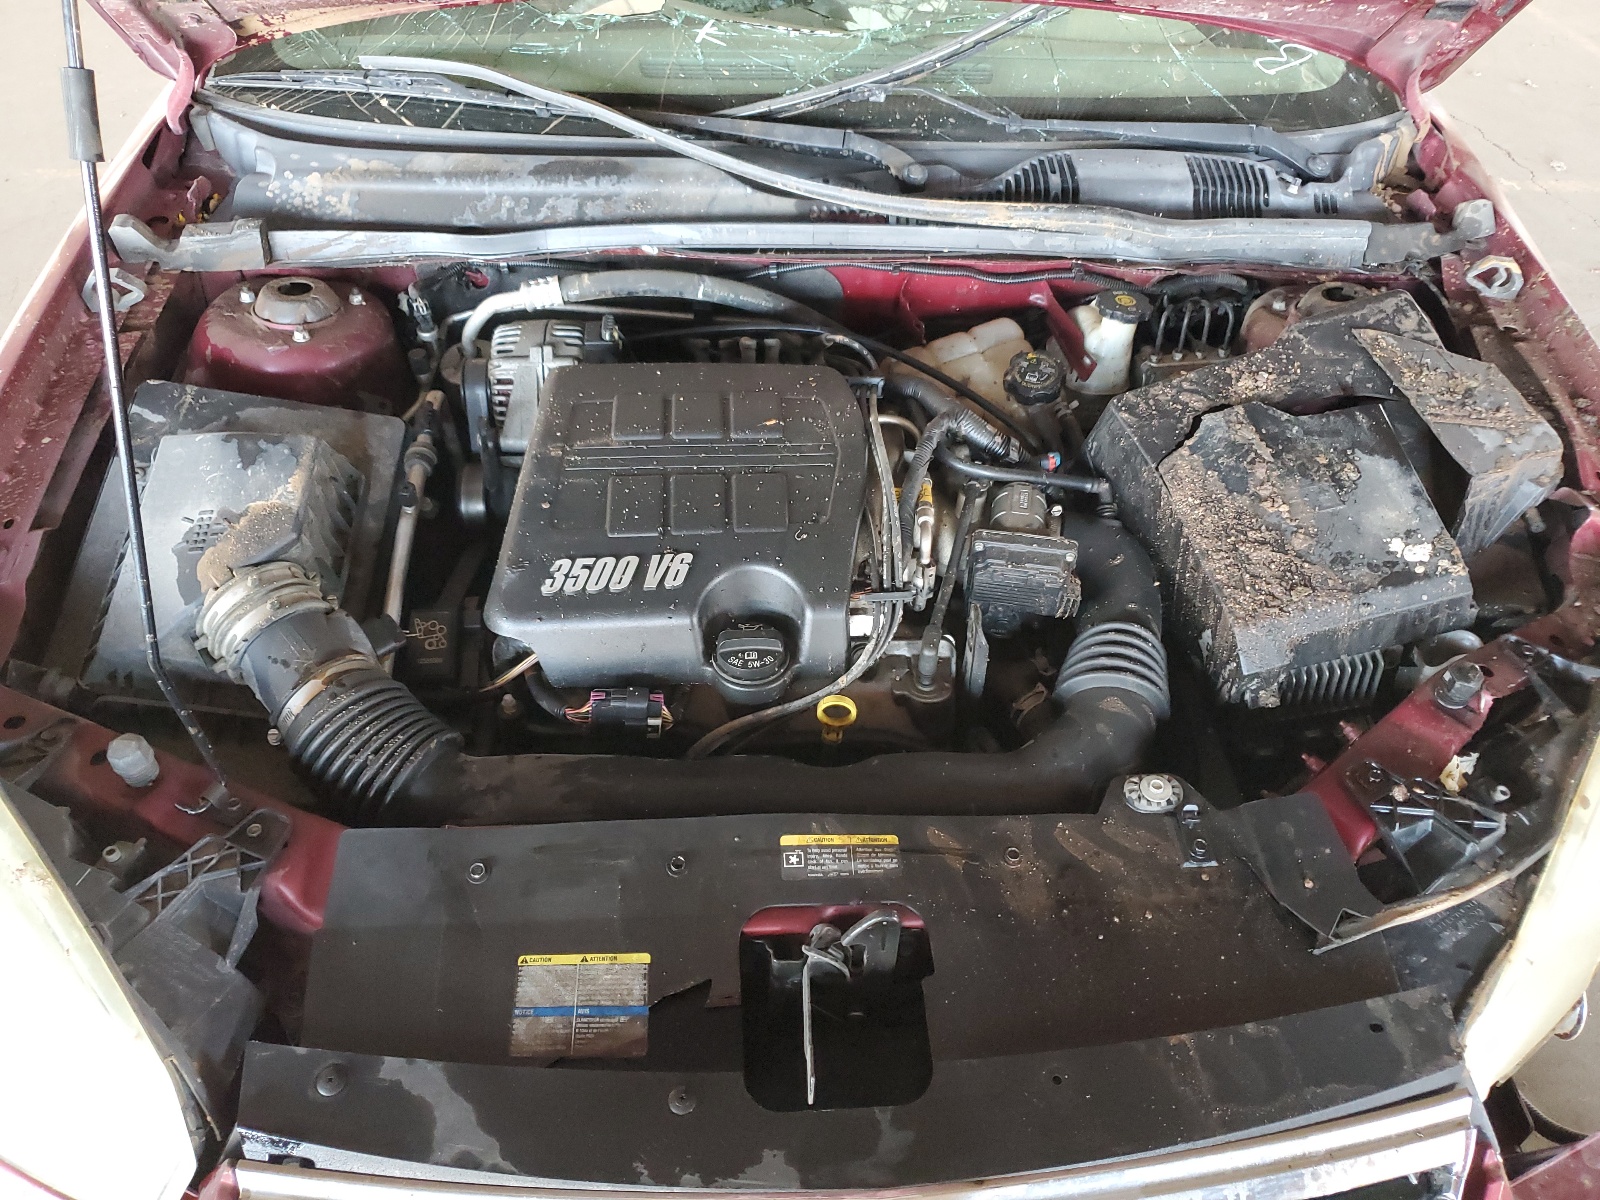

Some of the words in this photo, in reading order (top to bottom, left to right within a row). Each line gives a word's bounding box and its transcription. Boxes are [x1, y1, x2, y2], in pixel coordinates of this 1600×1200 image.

[541, 555, 640, 596] 3500
[643, 552, 694, 591] V6
[727, 656, 745, 667] SAE
[747, 655, 775, 668] 5W-30
